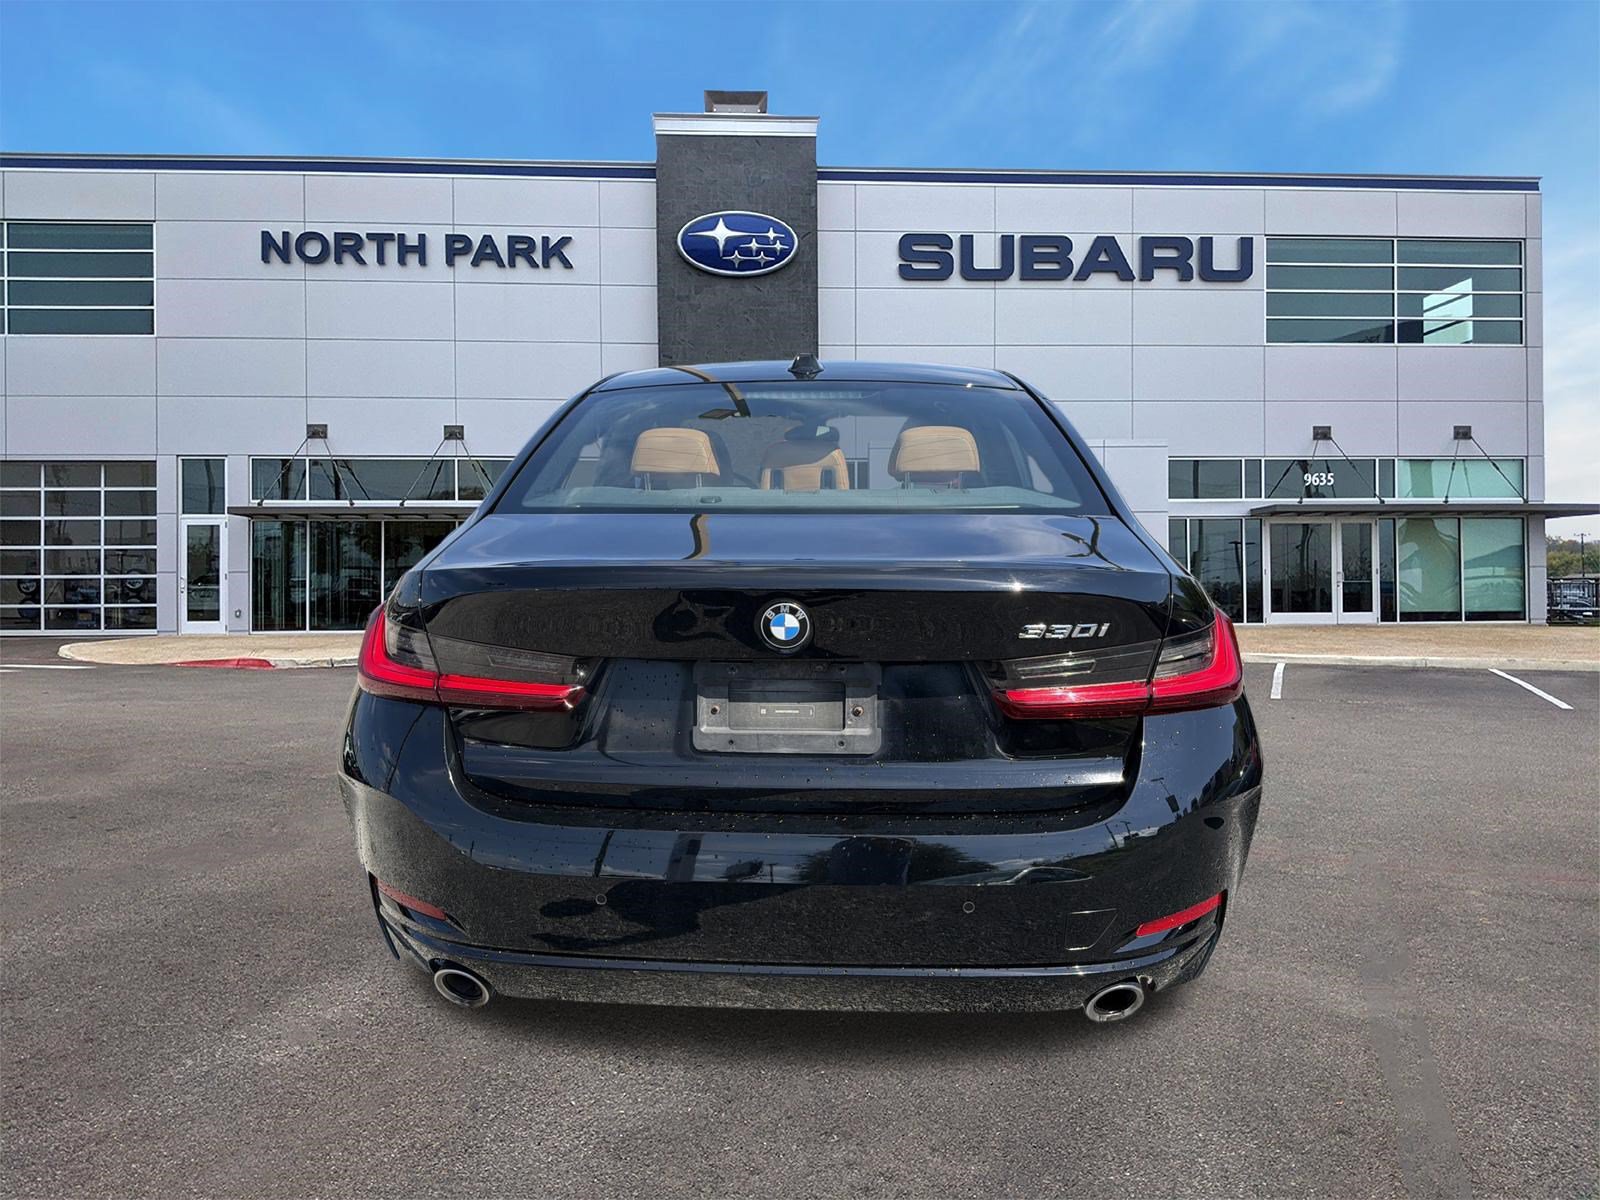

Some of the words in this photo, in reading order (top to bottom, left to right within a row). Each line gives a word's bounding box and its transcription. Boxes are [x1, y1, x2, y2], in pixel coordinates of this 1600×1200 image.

[261, 230, 427, 266] NORTH
[445, 234, 574, 269] PARK
[898, 232, 1254, 282] SUBARU
[1303, 472, 1335, 486] 9635
[765, 604, 805, 620] BMW
